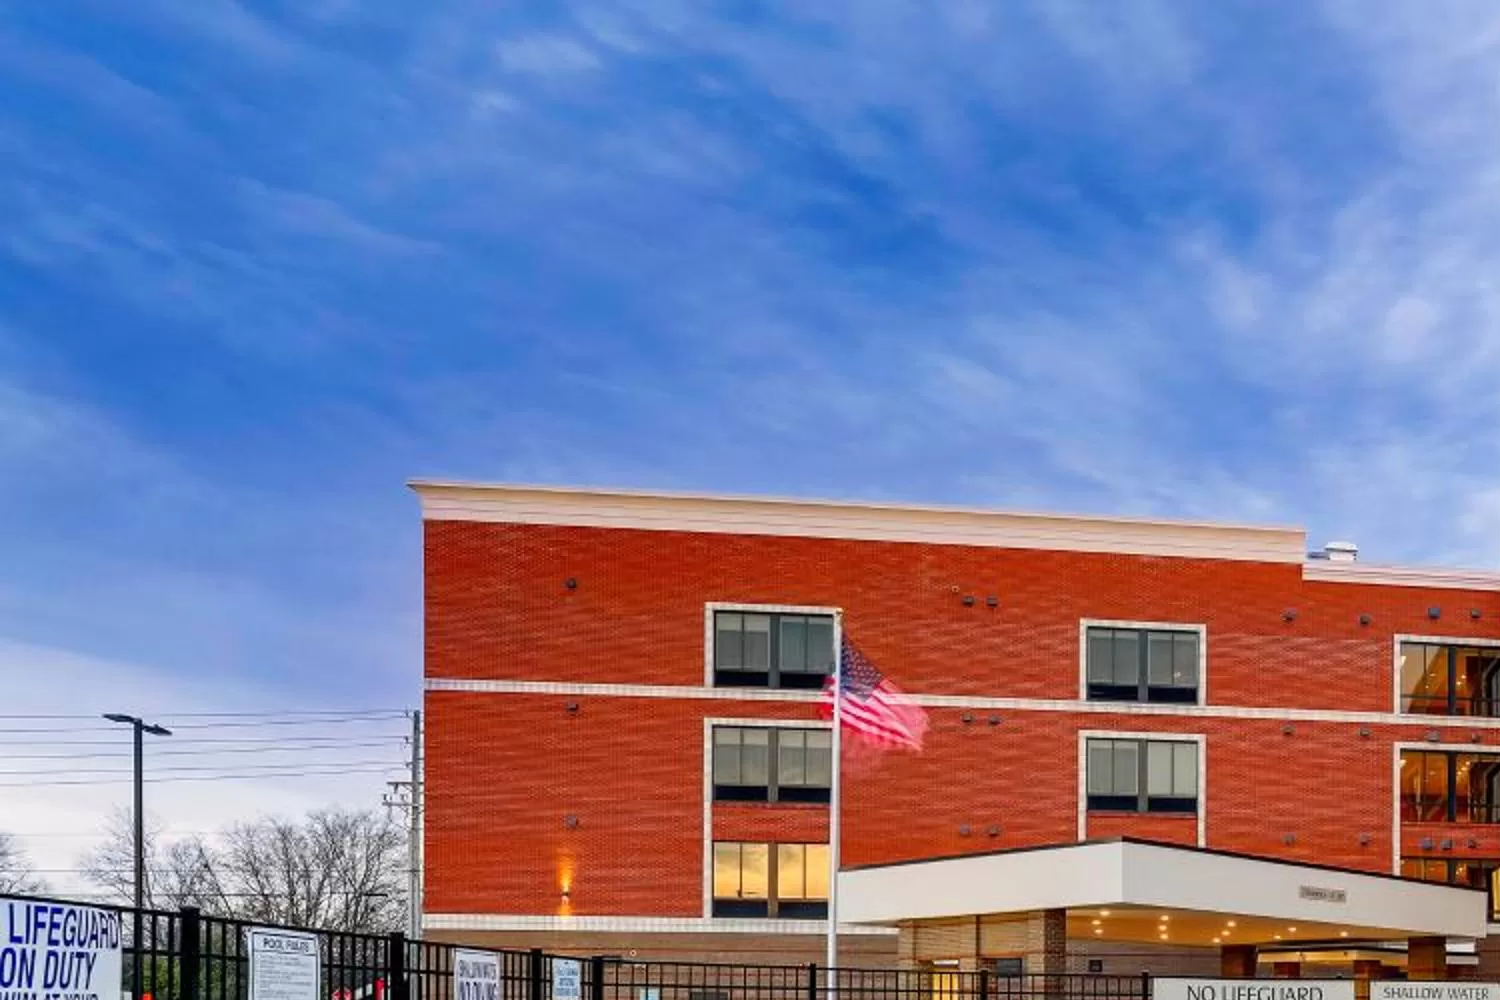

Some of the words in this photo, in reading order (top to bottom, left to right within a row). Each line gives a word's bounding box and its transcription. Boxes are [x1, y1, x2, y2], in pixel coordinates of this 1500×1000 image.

[9, 903, 119, 948] LIFEGUARD
[0, 948, 36, 988] ON
[43, 950, 97, 989] DUTY
[1383, 987, 1444, 1000] SHALLOW
[1447, 988, 1489, 1000] WATER
